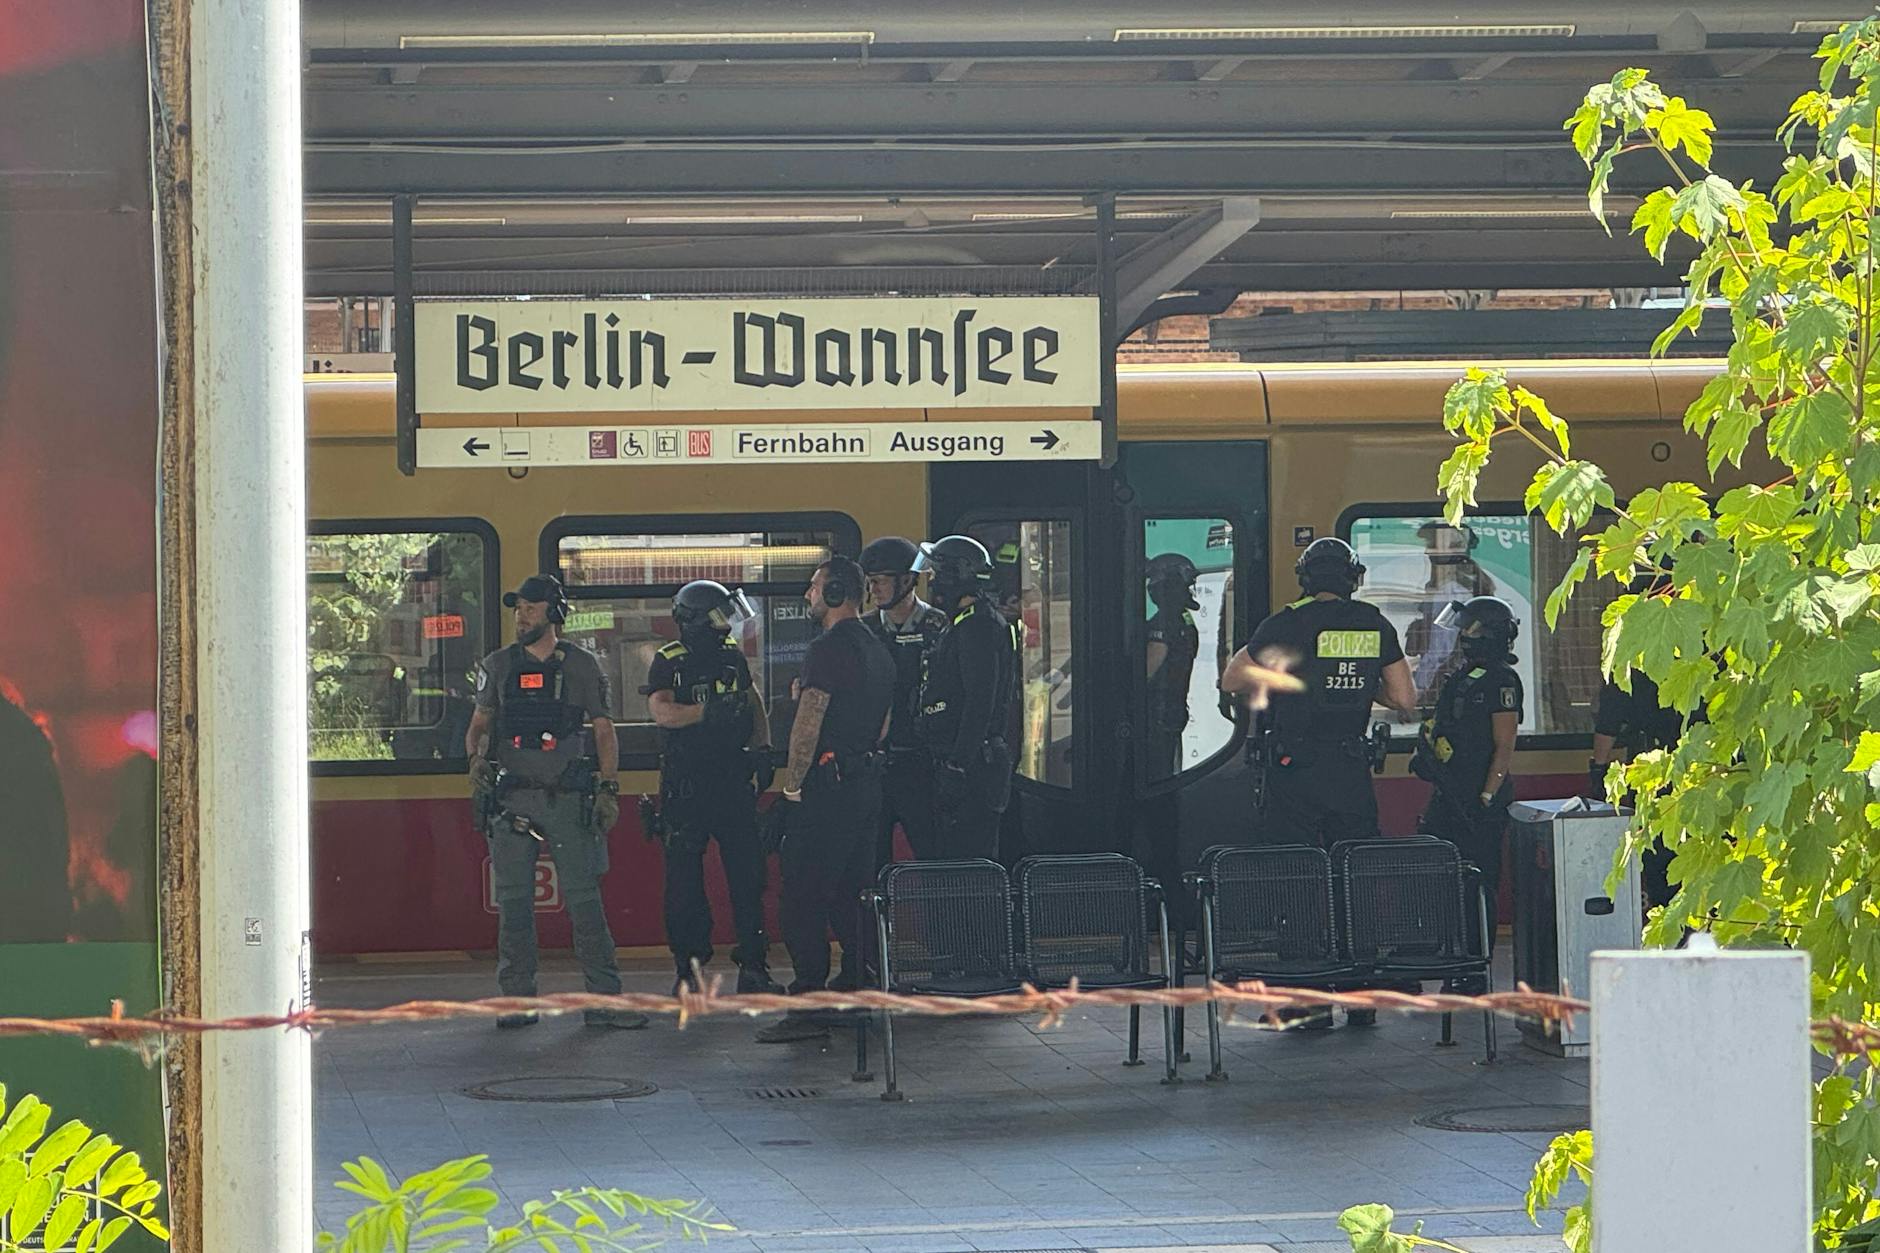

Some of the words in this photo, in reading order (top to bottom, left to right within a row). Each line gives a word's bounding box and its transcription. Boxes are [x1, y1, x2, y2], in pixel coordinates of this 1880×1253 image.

[690, 431, 710, 455] BUS
[738, 431, 865, 454] Fernbahn
[889, 431, 1005, 456] Ausgang
[1338, 662, 1356, 675] BE
[1326, 676, 1365, 689] 32115
